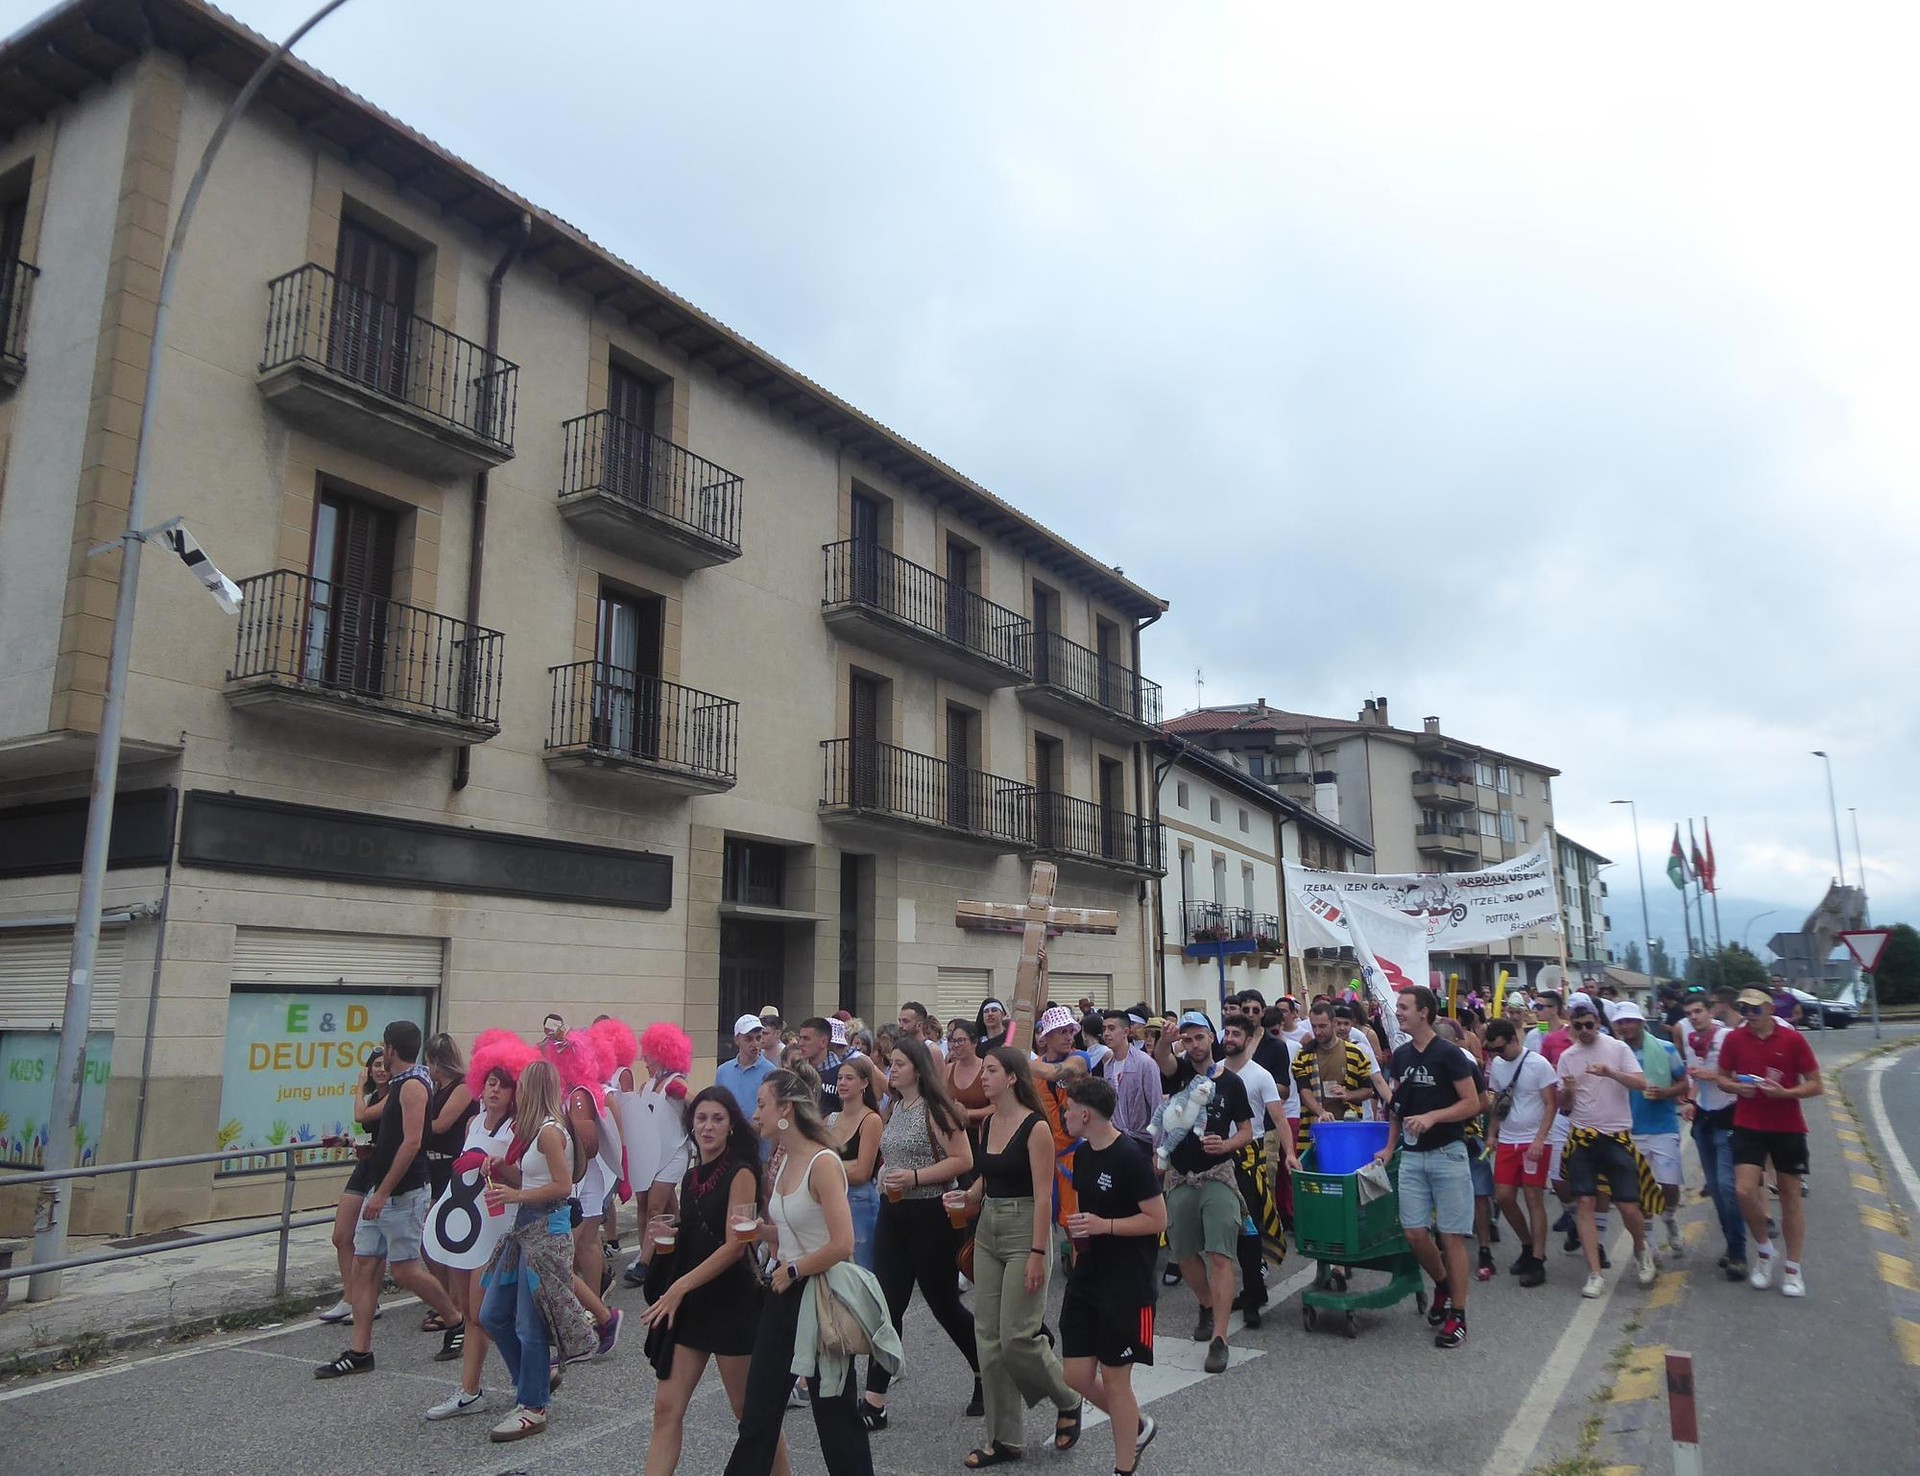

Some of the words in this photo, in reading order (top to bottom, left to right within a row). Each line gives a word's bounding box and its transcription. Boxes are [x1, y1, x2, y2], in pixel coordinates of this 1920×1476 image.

[1344, 883, 1368, 892] IZEN
[1469, 896, 1499, 906] ITZEL
[286, 1003, 310, 1033] E
[319, 1012, 337, 1033] &
[346, 1004, 369, 1033] D
[248, 1040, 384, 1072] DEUTSC
[9, 1059, 44, 1083] KIDS
[276, 1084, 312, 1103] jung
[317, 1082, 345, 1097] und
[435, 1147, 487, 1255] 8
